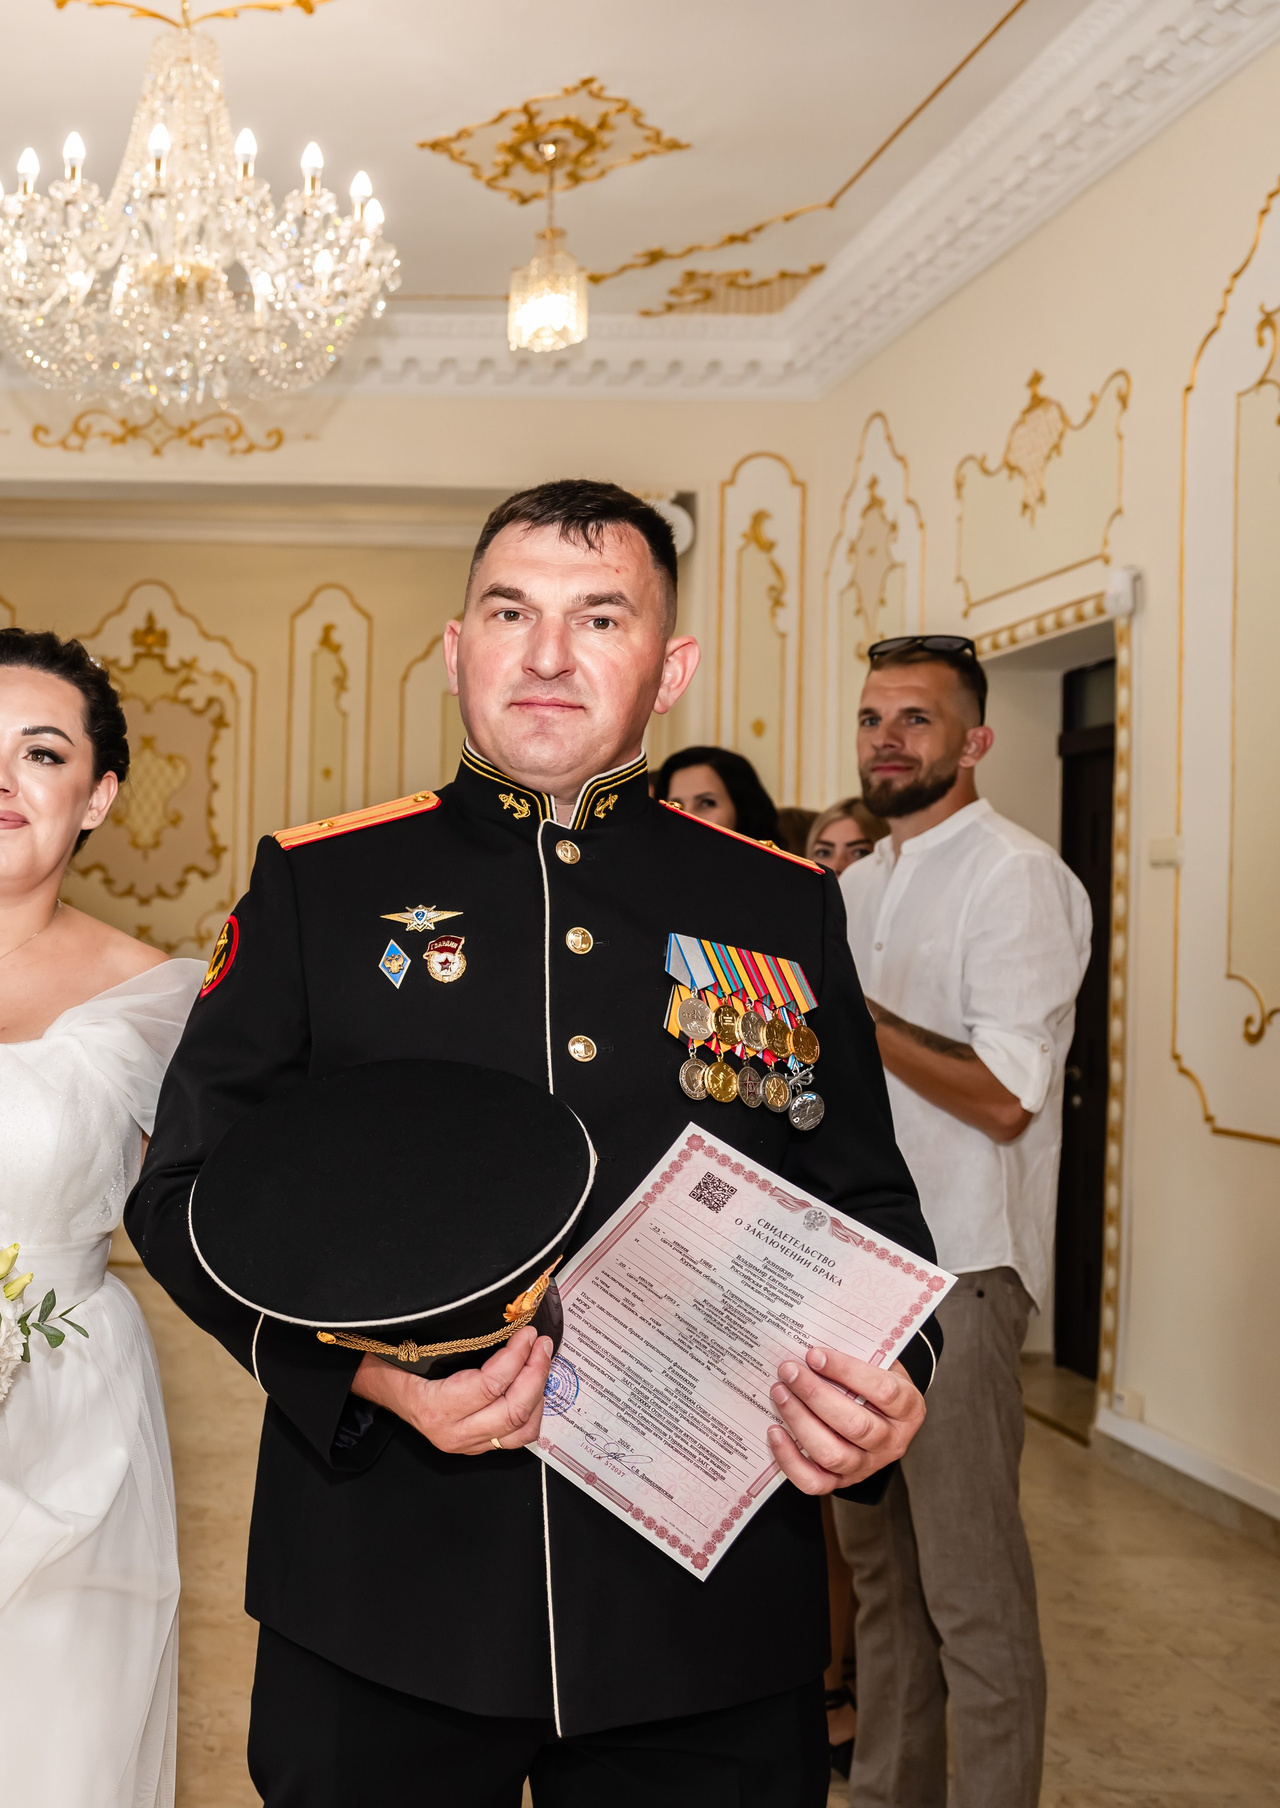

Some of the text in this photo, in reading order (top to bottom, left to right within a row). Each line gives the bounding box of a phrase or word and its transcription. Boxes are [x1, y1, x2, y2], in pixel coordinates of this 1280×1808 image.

[733, 1217, 844, 1287] О ЗАКЛЮЧЕНИИ БРАКА
[755, 1217, 836, 1268] СВИДЕТЕЛЬСТВО
[734, 1254, 769, 1277] Владимир
[761, 1285, 794, 1309] Федерация
